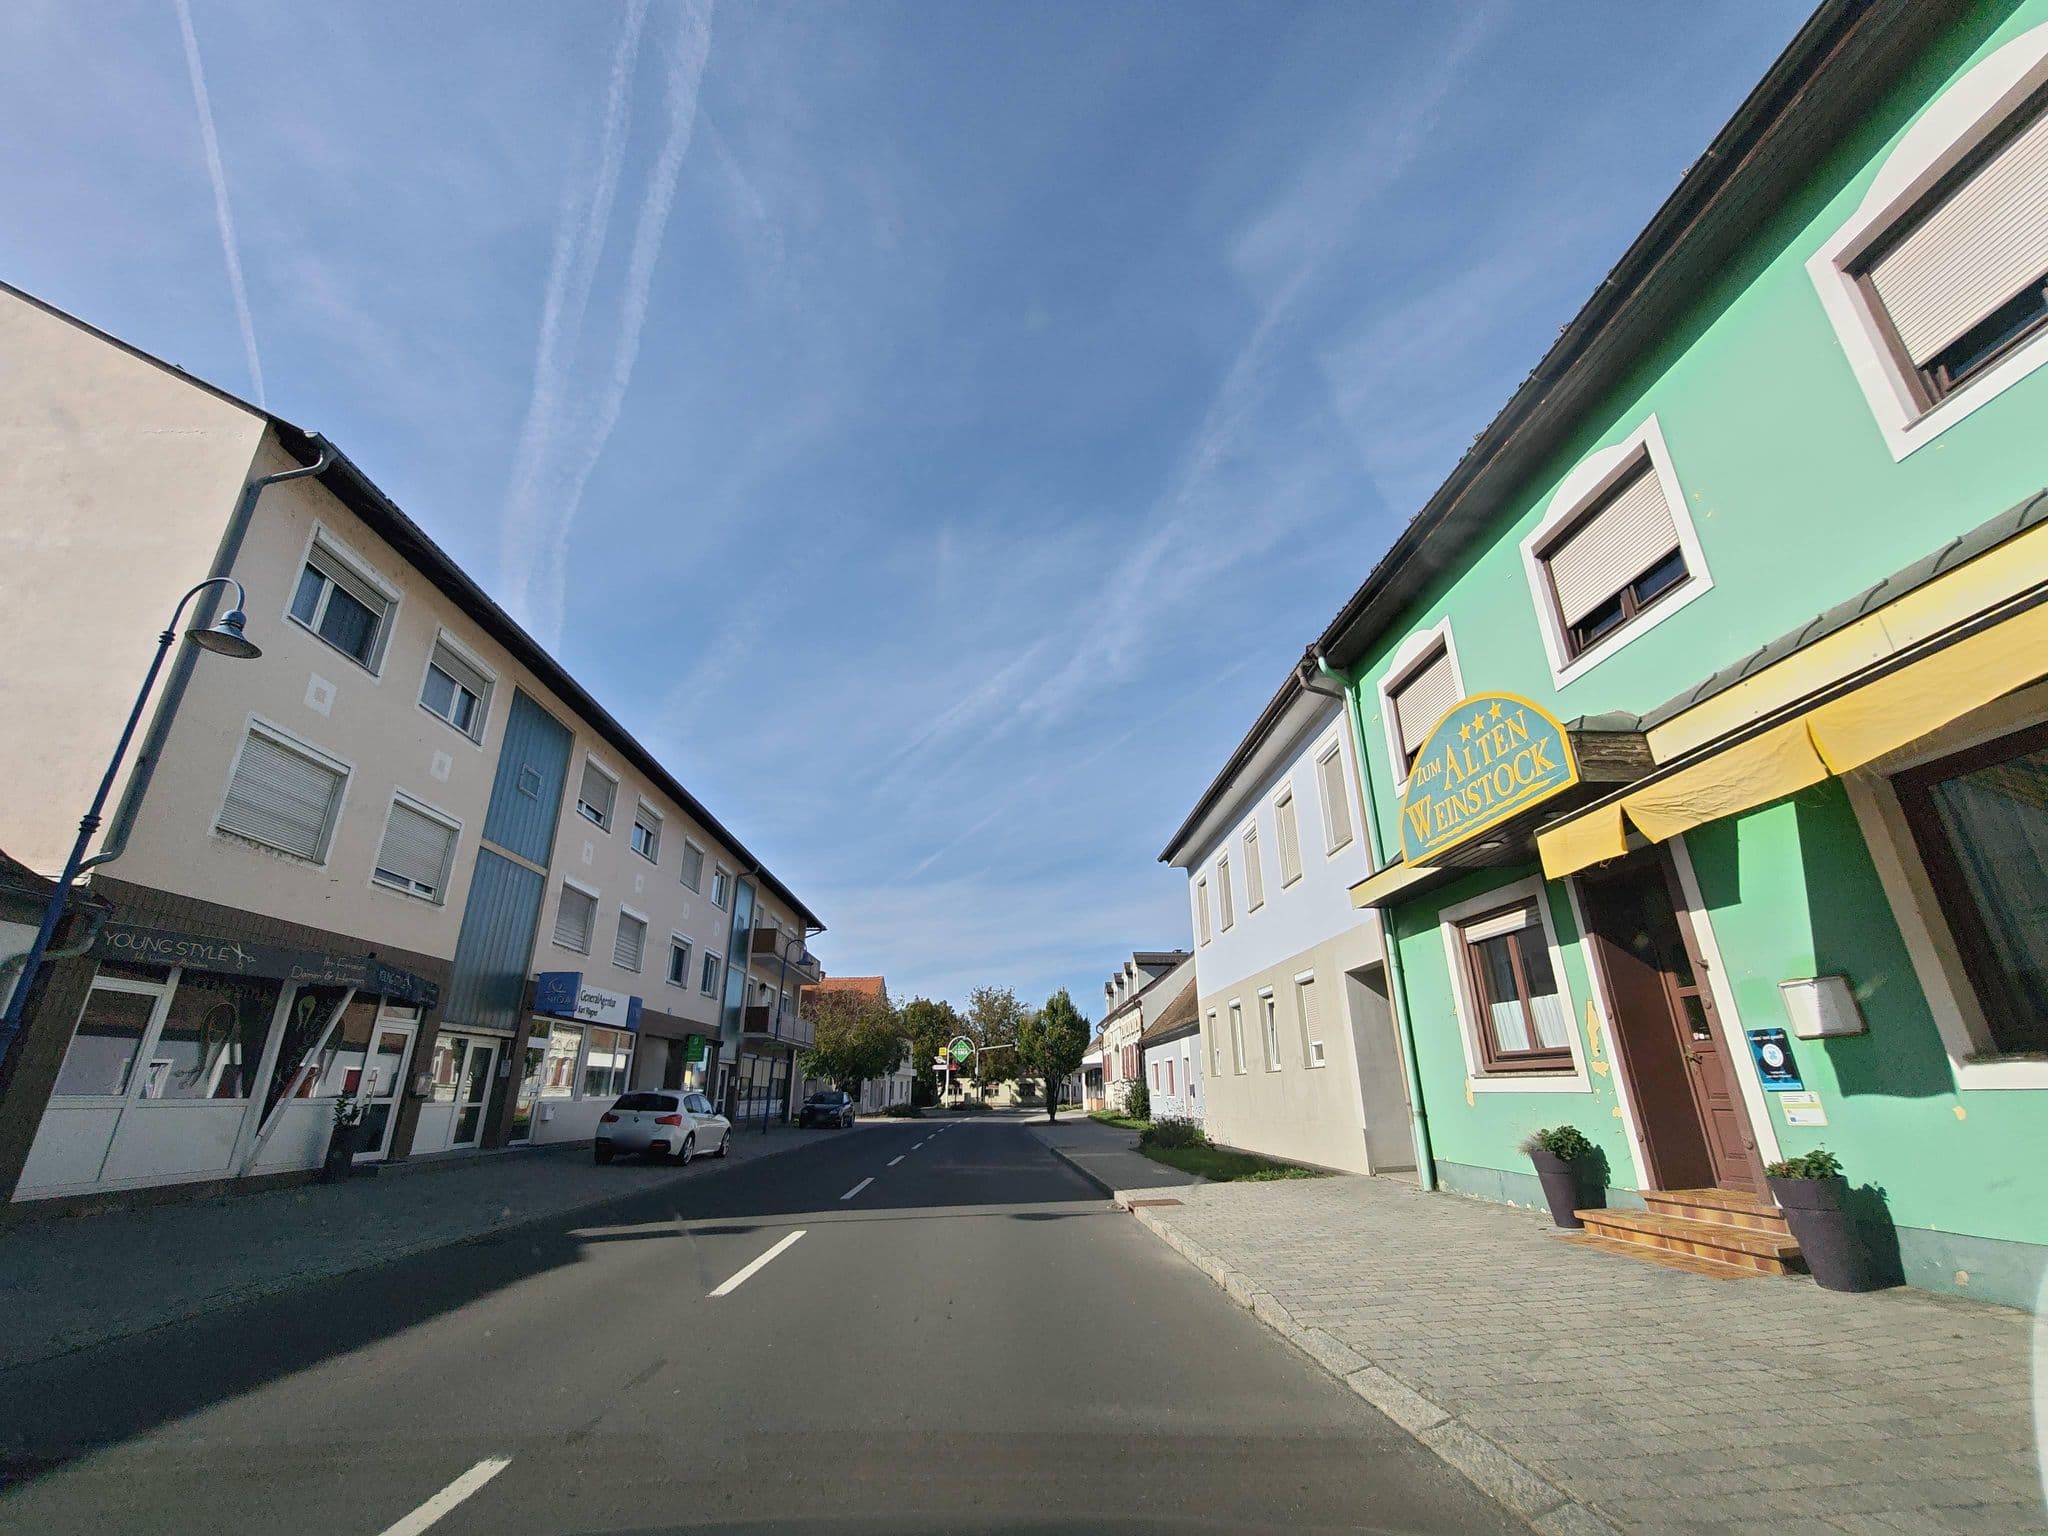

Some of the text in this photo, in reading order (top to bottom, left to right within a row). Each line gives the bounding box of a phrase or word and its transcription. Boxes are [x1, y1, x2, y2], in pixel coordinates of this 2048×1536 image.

[1406, 736, 1556, 843] WEINSTOCK
[1416, 708, 1530, 791] ZUM ALTEN
